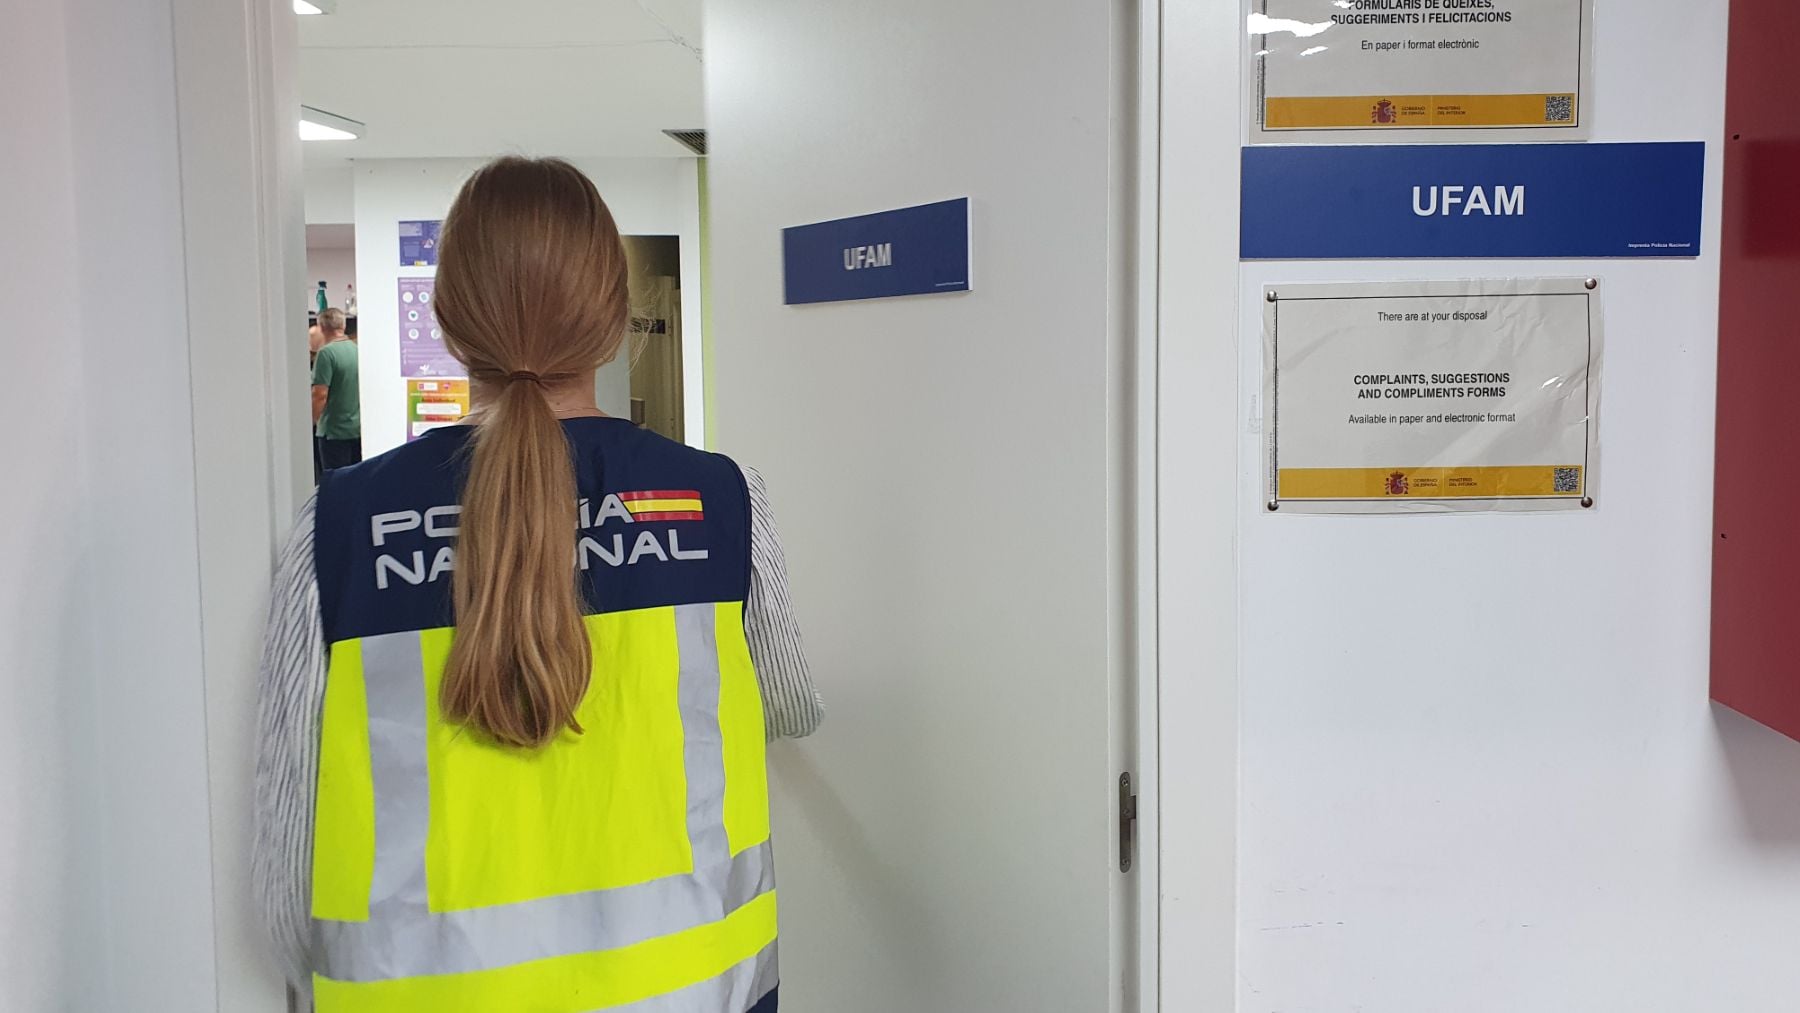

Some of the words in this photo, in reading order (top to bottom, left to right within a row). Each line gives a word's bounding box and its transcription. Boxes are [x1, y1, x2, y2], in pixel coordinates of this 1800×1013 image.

[1425, 0, 1439, 9] DE
[1443, 0, 1494, 10] QUEIXES,
[1331, 13, 1419, 25] SUGGERIMENTS
[1422, 12, 1425, 23] I
[1429, 11, 1512, 23] FELICITACIONS
[1361, 40, 1373, 50] En
[1375, 42, 1401, 52] paper
[1408, 39, 1436, 50] format
[1412, 185, 1525, 217] UFAM
[843, 242, 892, 271] UFAM
[1378, 311, 1403, 322] There
[1405, 313, 1419, 321] are
[1421, 312, 1429, 321] at
[1432, 312, 1450, 323] your
[1452, 310, 1488, 322] disposal
[1353, 374, 1429, 386] COMPLAINTS,
[1431, 372, 1510, 384] SUGGESTIONS
[1357, 389, 1382, 399] AND
[1384, 387, 1465, 399] COMPLIMENTS
[1467, 386, 1506, 397] FORMS
[1348, 413, 1387, 424] Available
[1389, 414, 1397, 423] in
[1399, 414, 1424, 425] paper
[1426, 413, 1443, 423] and
[1444, 412, 1485, 423] electronic
[1487, 412, 1516, 422] format
[371, 493, 635, 547] POÍA
[375, 528, 709, 590] NANAL
